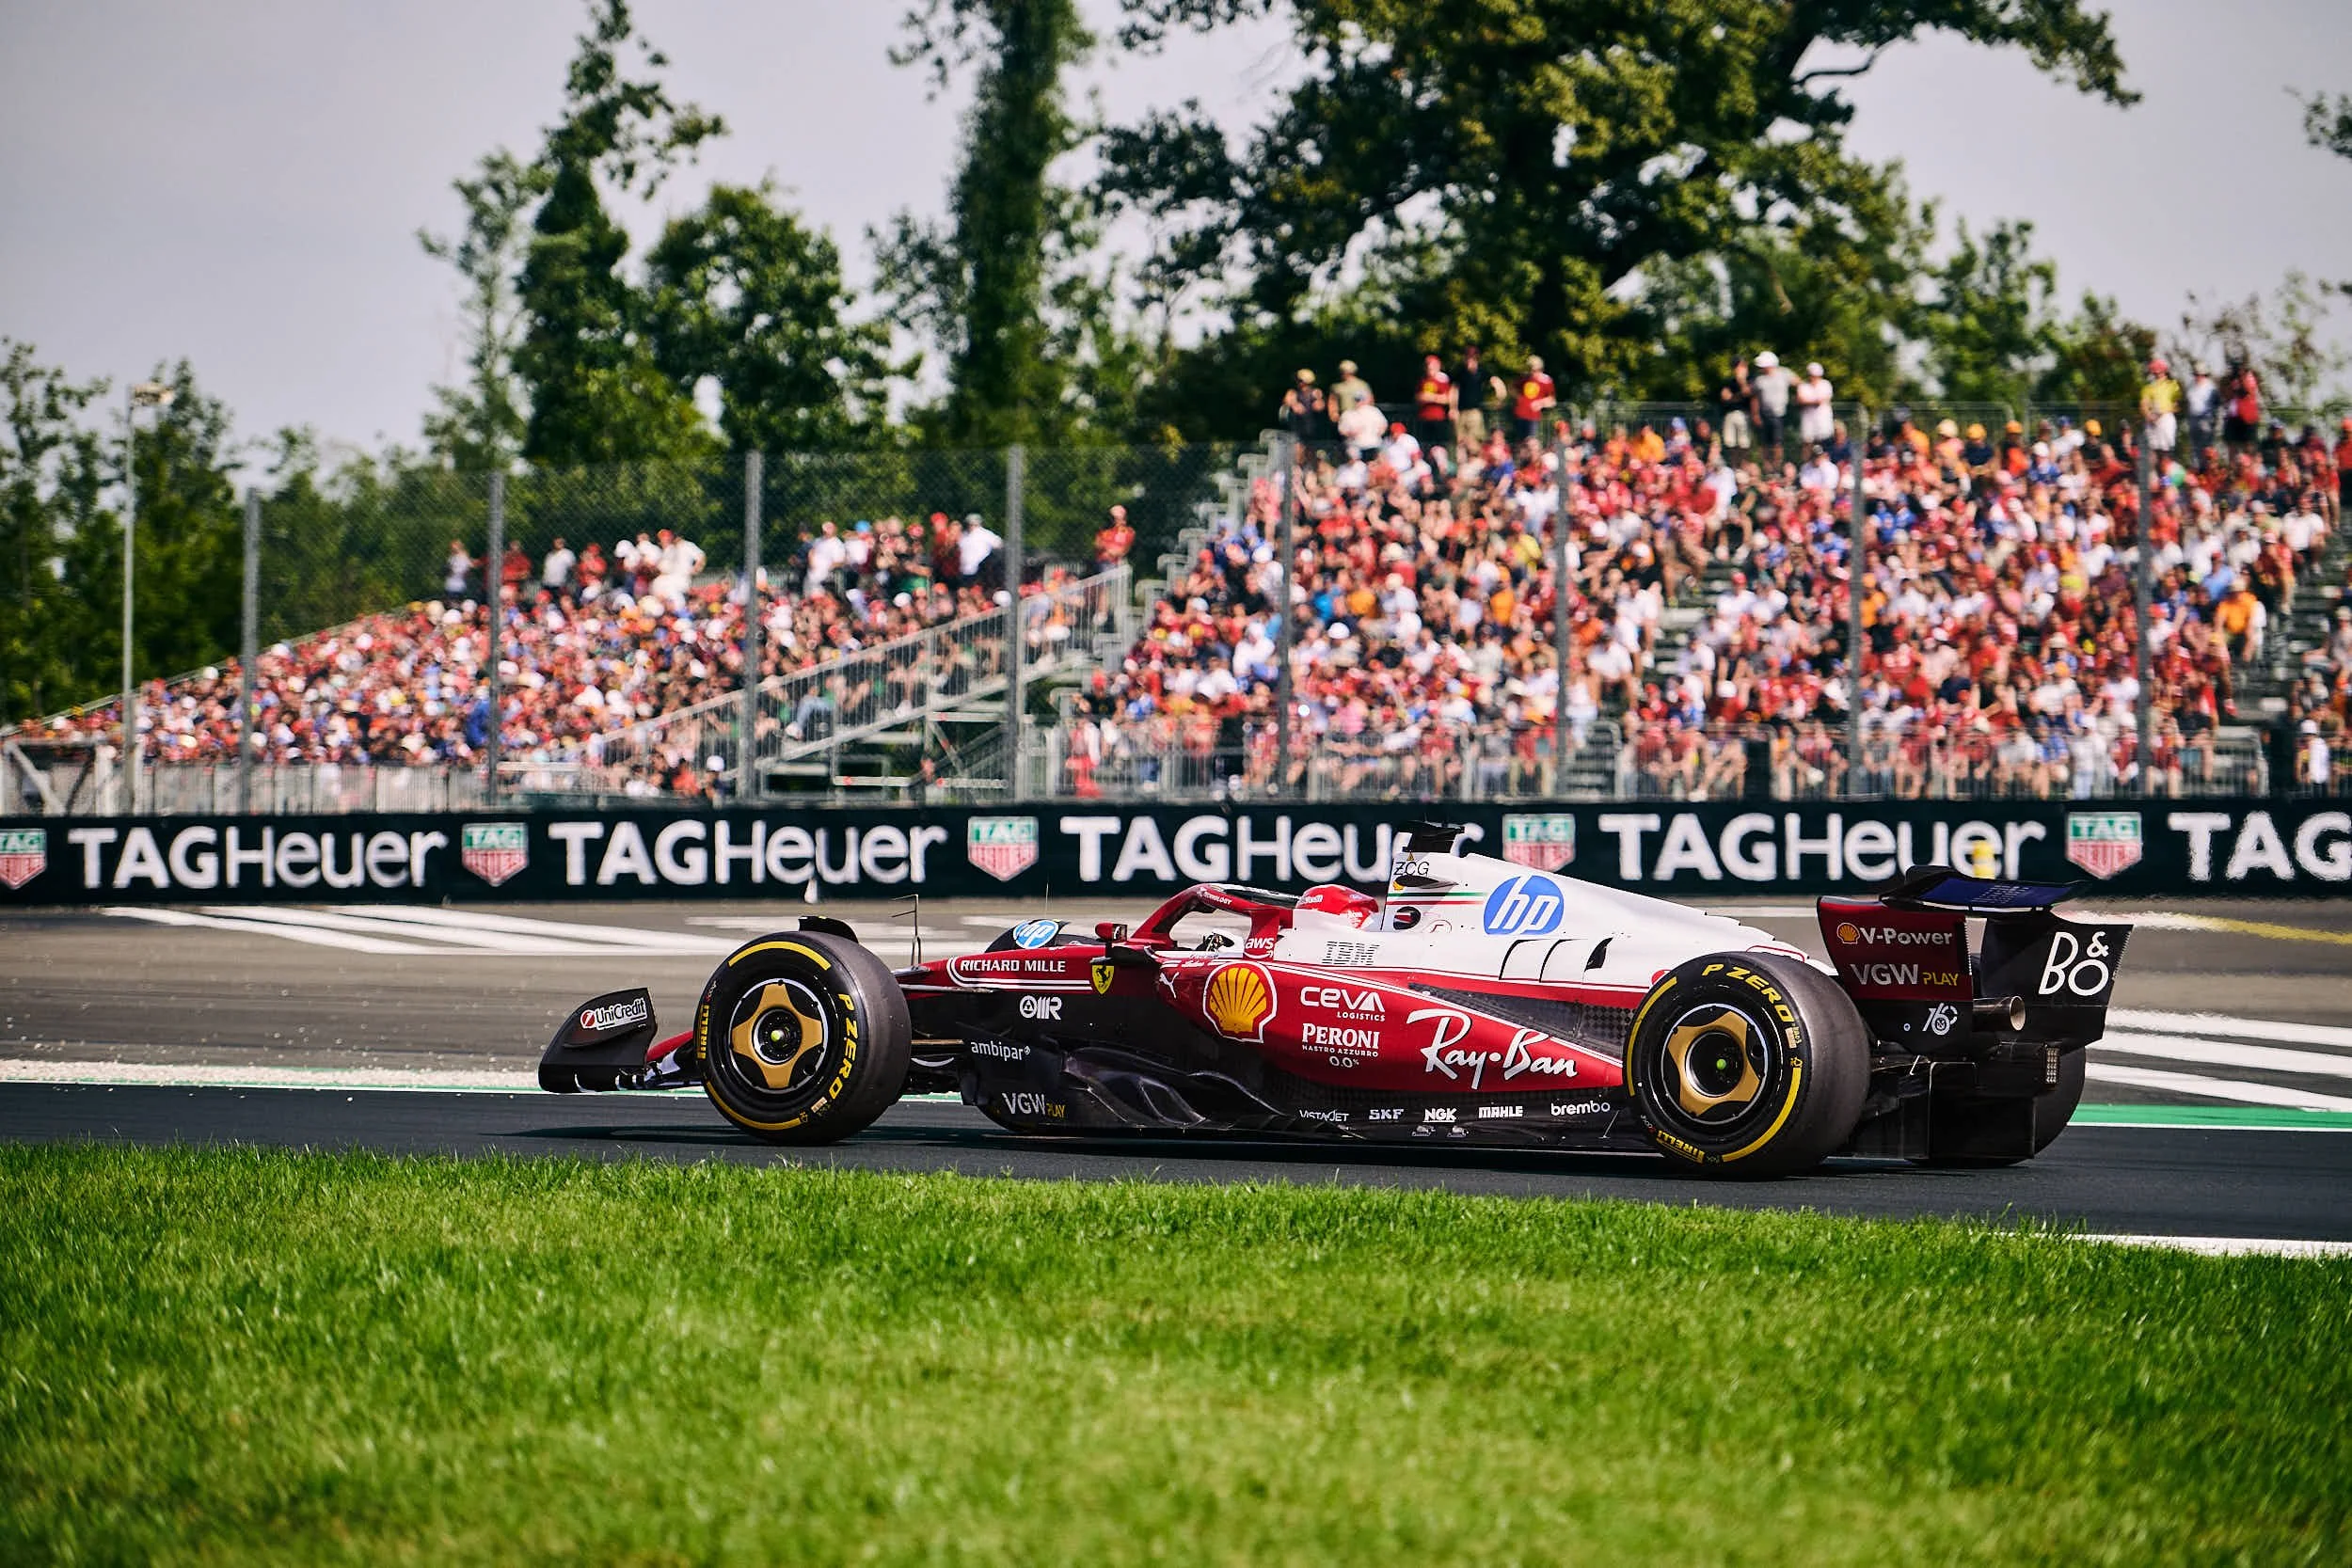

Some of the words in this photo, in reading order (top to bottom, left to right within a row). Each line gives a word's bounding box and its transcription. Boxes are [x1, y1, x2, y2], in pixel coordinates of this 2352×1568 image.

[2073, 816, 2137, 838] TAG
[1393, 861, 1430, 876] ZCG
[1488, 874, 1561, 934] hp
[1245, 937, 1275, 950] aws
[1859, 927, 1953, 944] V-Power
[1321, 941, 1381, 966] IBM
[960, 959, 1020, 972] RICHARD
[1025, 959, 1066, 973] MILLE
[1849, 962, 1919, 986] VGW
[1921, 972, 1959, 986] PLAY
[1725, 966, 1795, 1022] ZERO
[595, 997, 646, 1024] UniCredit
[1336, 1011, 1386, 1022] LOGISTICS
[696, 1004, 710, 1060] PIRELLI
[1301, 1022, 1380, 1050] PERONI
[828, 1017, 859, 1100] ZERO
[1301, 1044, 1336, 1054] NASTRO
[1337, 1048, 1379, 1058] AZZURRO
[1001, 1092, 1046, 1116] VGW
[1368, 1108, 1405, 1120] SKF
[1422, 1107, 1457, 1123] NGK
[1478, 1105, 1524, 1118] MAHLE
[1550, 1100, 1611, 1117] brembo
[1656, 1130, 1706, 1164] PIRELLI
